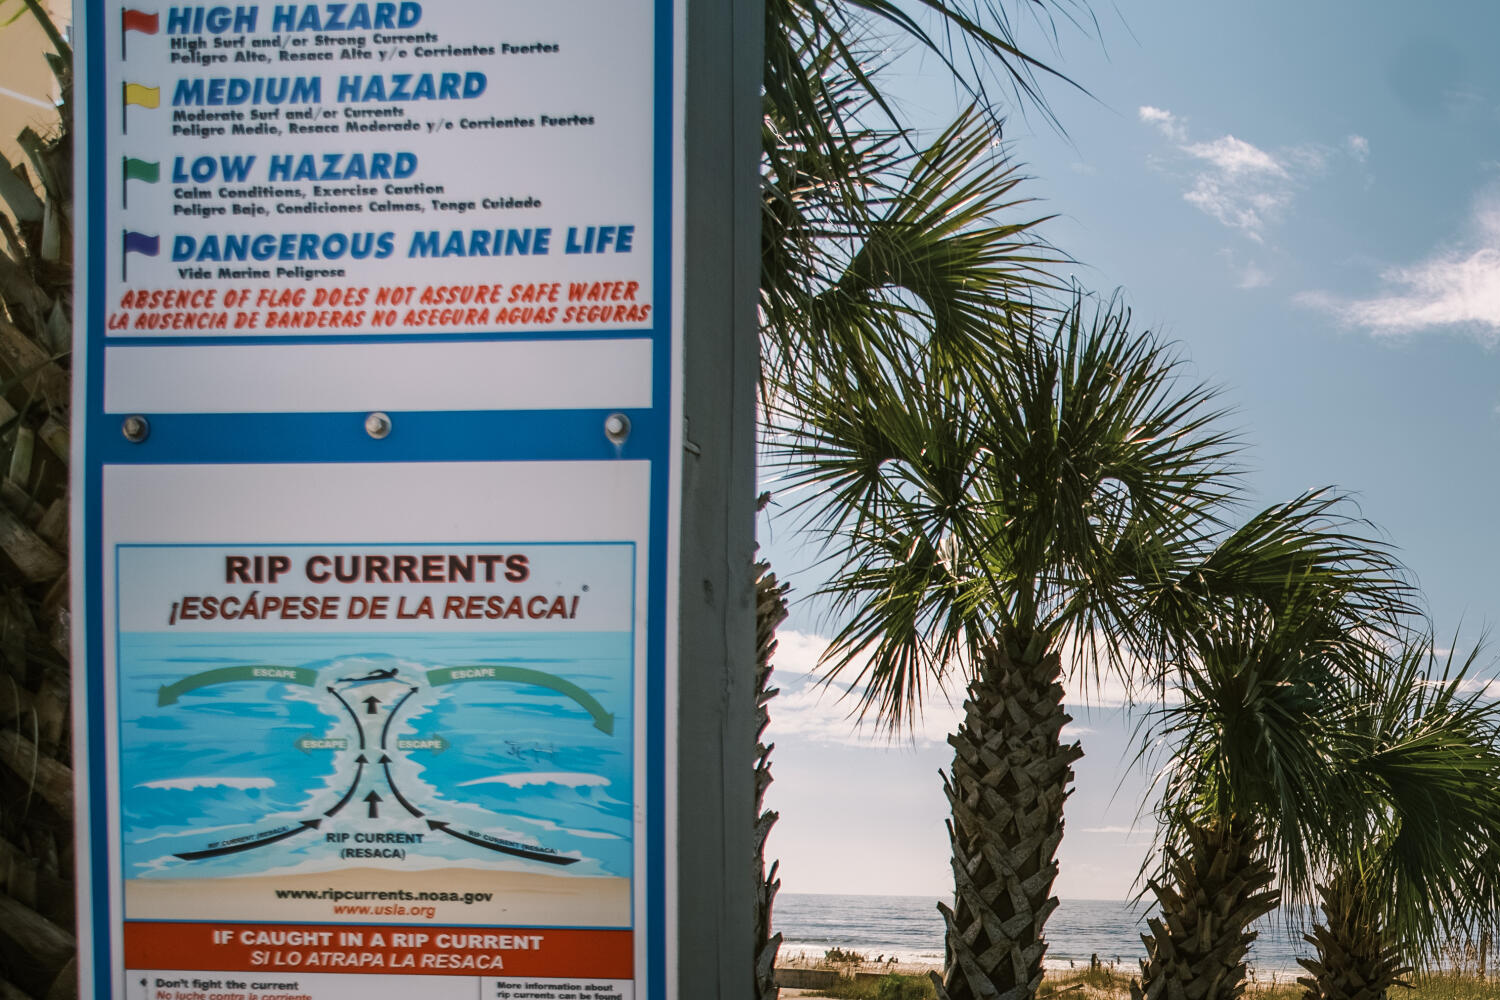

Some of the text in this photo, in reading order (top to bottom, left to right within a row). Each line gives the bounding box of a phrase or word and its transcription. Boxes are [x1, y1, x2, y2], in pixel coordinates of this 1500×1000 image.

[167, 2, 422, 34] HIGH HAZARD
[170, 32, 439, 51] High Surf and/or Strong Currents
[172, 72, 487, 105] MEDIUM HAZARD
[172, 106, 405, 121] Moderate Surf and/or Currents
[172, 152, 418, 183] LOW HAZARD
[173, 186, 212, 199] Calm
[313, 185, 378, 196] Exercise
[384, 183, 444, 194] Caution
[172, 225, 634, 261] DANGEROUS MARINE LIFE
[178, 266, 345, 280] Vida Marina Peligrosa
[120, 281, 639, 308] ABSENCE OF FLAG DOES NOT ASSURE SAFE WATER
[104, 305, 652, 331] LA AUSENCIA DE BANDERAS NO ASEGURA AGUAS SEGURAS
[225, 555, 530, 583] RIP CURRENTS
[169, 592, 580, 623] ¡ESCÁPESE DE LA RESACA!
[252, 669, 296, 678] ESCAPE
[450, 668, 495, 679] ESCAPE
[302, 739, 347, 751] ESCAPE
[398, 739, 442, 751] ESCAPE
[326, 833, 424, 845] RIP CURRENT
[340, 847, 407, 861] (RESACA)
[275, 889, 493, 904] www.ripcurrents.noaa.gov
[333, 904, 436, 918] www.usla.org
[213, 930, 544, 949] IF CAUGHT IN A RIP CURRENT
[251, 950, 504, 968] SI LO ATRAPA LA RESACA
[154, 978, 299, 991] Don't fight the current
